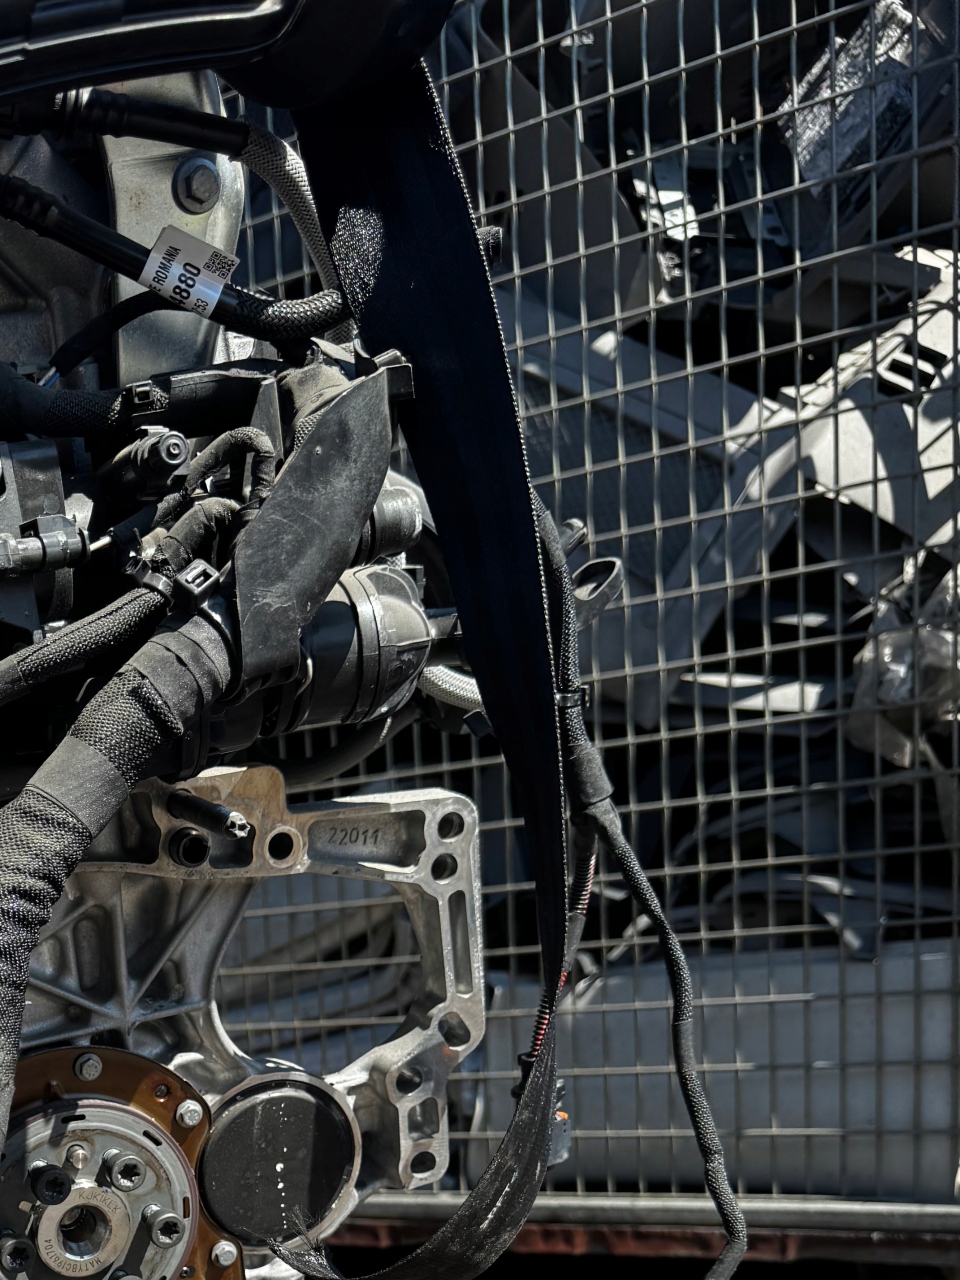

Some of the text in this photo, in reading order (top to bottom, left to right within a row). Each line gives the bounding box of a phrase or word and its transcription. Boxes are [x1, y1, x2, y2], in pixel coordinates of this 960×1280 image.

[152, 245, 181, 286] ROMANIA
[169, 262, 201, 305] 4880
[327, 827, 381, 846] 22011
